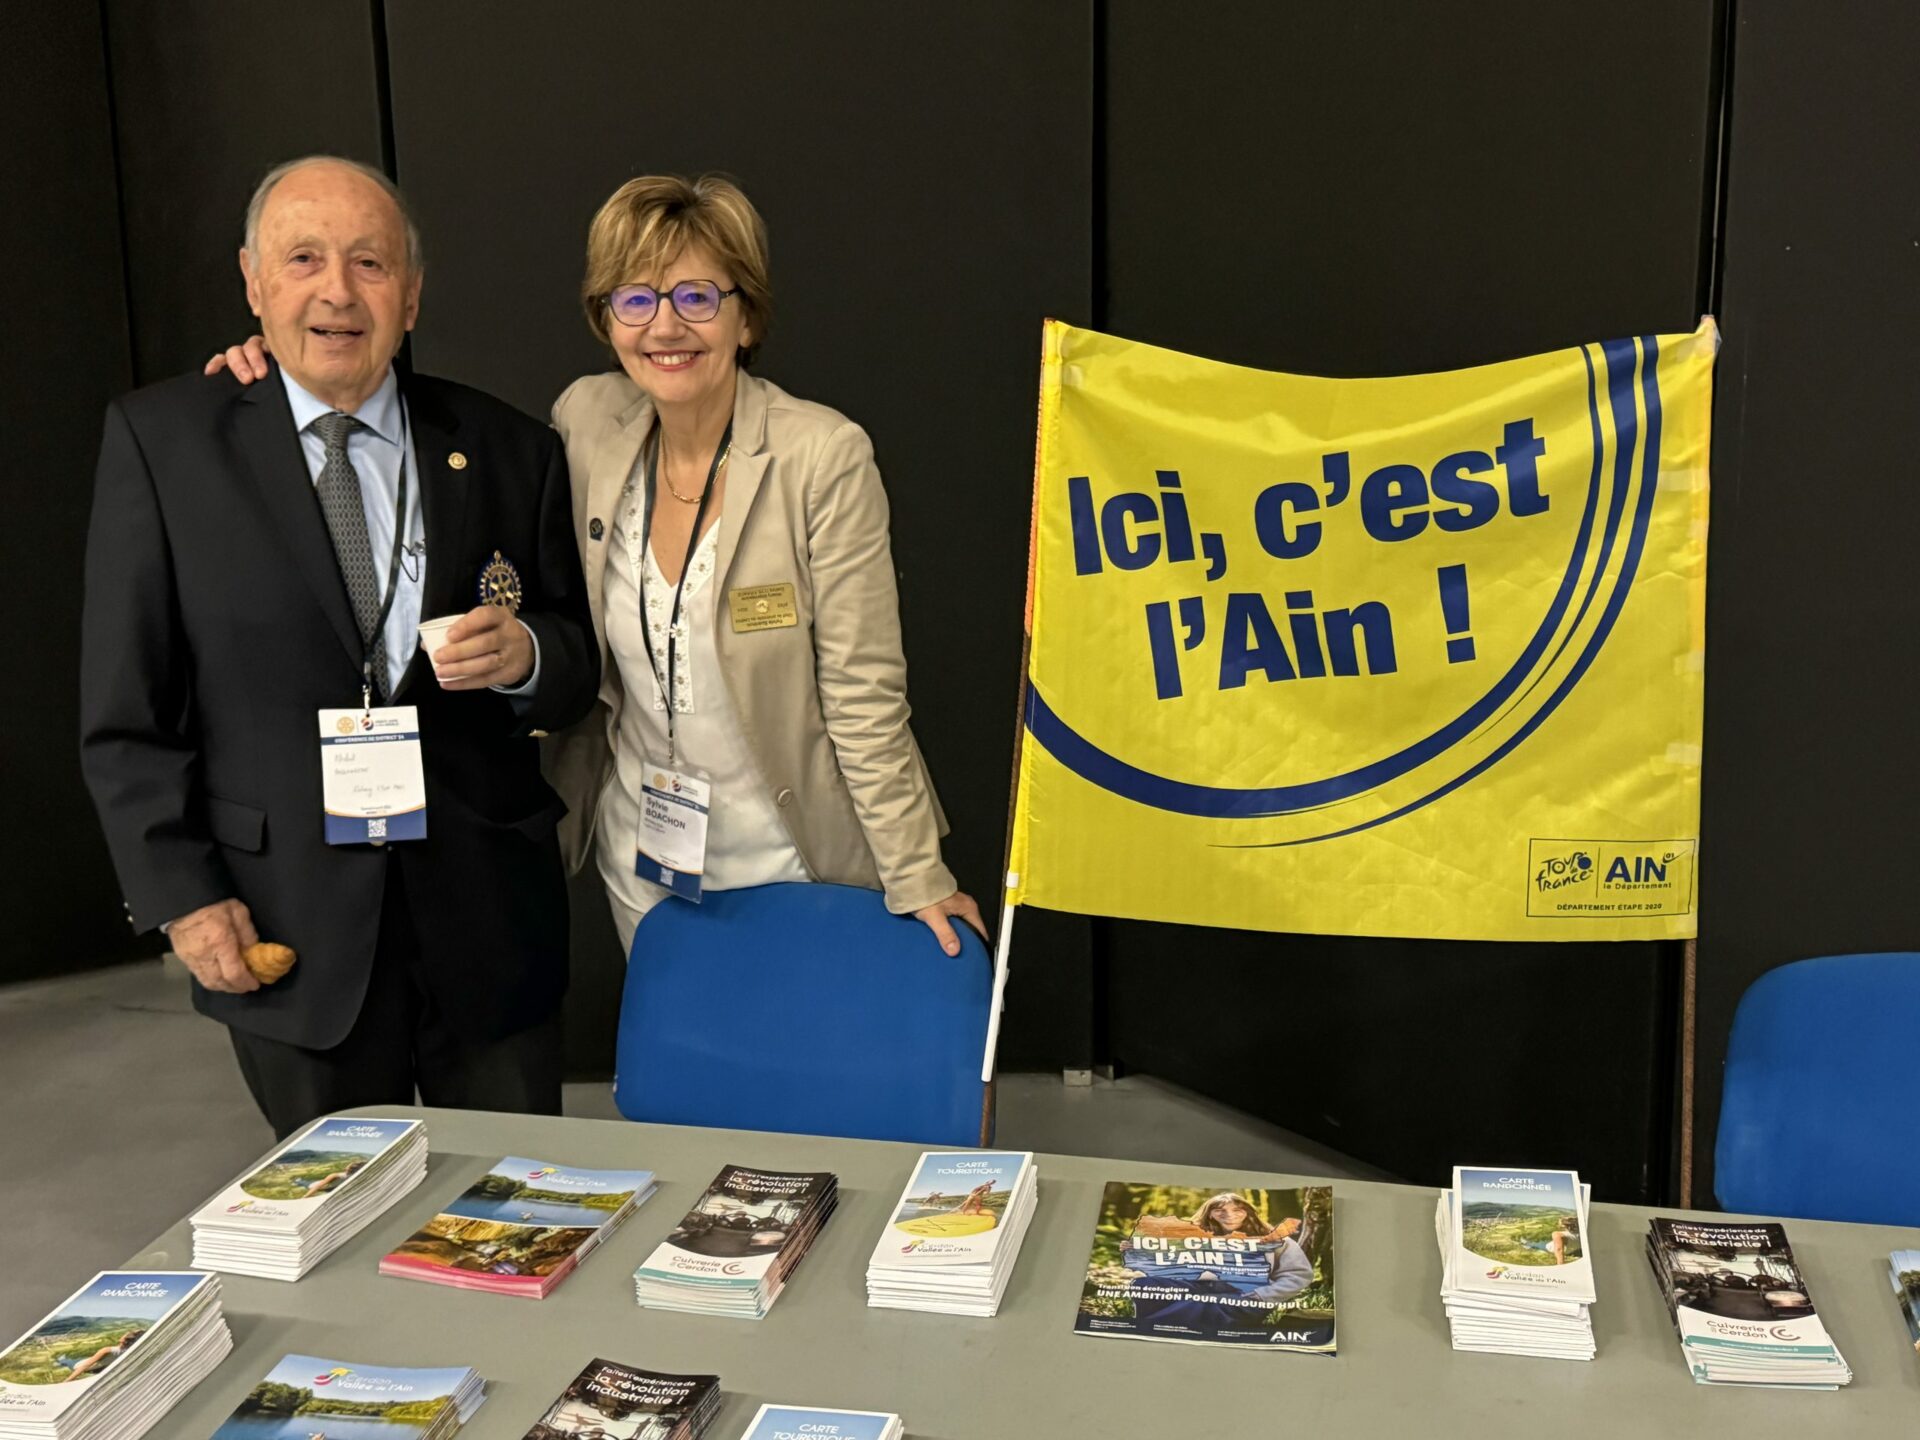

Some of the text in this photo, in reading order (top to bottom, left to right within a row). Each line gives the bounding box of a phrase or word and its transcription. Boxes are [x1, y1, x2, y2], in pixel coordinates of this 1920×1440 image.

[1068, 417, 1550, 581] Ici, c'est
[1145, 563, 1476, 700] l'Ain !
[1605, 856, 1667, 882] AIN
[1557, 903, 1615, 911] DÉPARTEMENT
[724, 1181, 797, 1194] industrielle
[747, 1178, 810, 1188] révolution
[1482, 1182, 1552, 1191] RANDONNÉE
[1675, 1235, 1761, 1247] industrielle
[1694, 1231, 1769, 1240] révolution
[1133, 1237, 1260, 1253] ICI, C'EST
[672, 1256, 721, 1267] Cuivrerie
[1155, 1251, 1244, 1267] L'AIN !
[677, 1263, 717, 1273] Cerdon
[125, 1282, 162, 1290] CARTE
[1142, 1285, 1190, 1293] écologique
[1097, 1290, 1121, 1298] UNE
[1122, 1291, 1182, 1301] AMBITION
[1184, 1294, 1217, 1303] POUR
[1219, 1297, 1301, 1309] AUJOURD'HUI
[1706, 1320, 1765, 1332] Cuivrerie
[1270, 1331, 1307, 1341] AIN
[1718, 1328, 1767, 1338] Cerdon
[601, 1366, 628, 1378] Faites
[628, 1373, 684, 1386] l'expérience
[337, 1379, 373, 1390] Vallée
[595, 1373, 690, 1395] la révolution
[586, 1381, 685, 1404] industrielle !
[798, 1423, 840, 1434] CARTE
